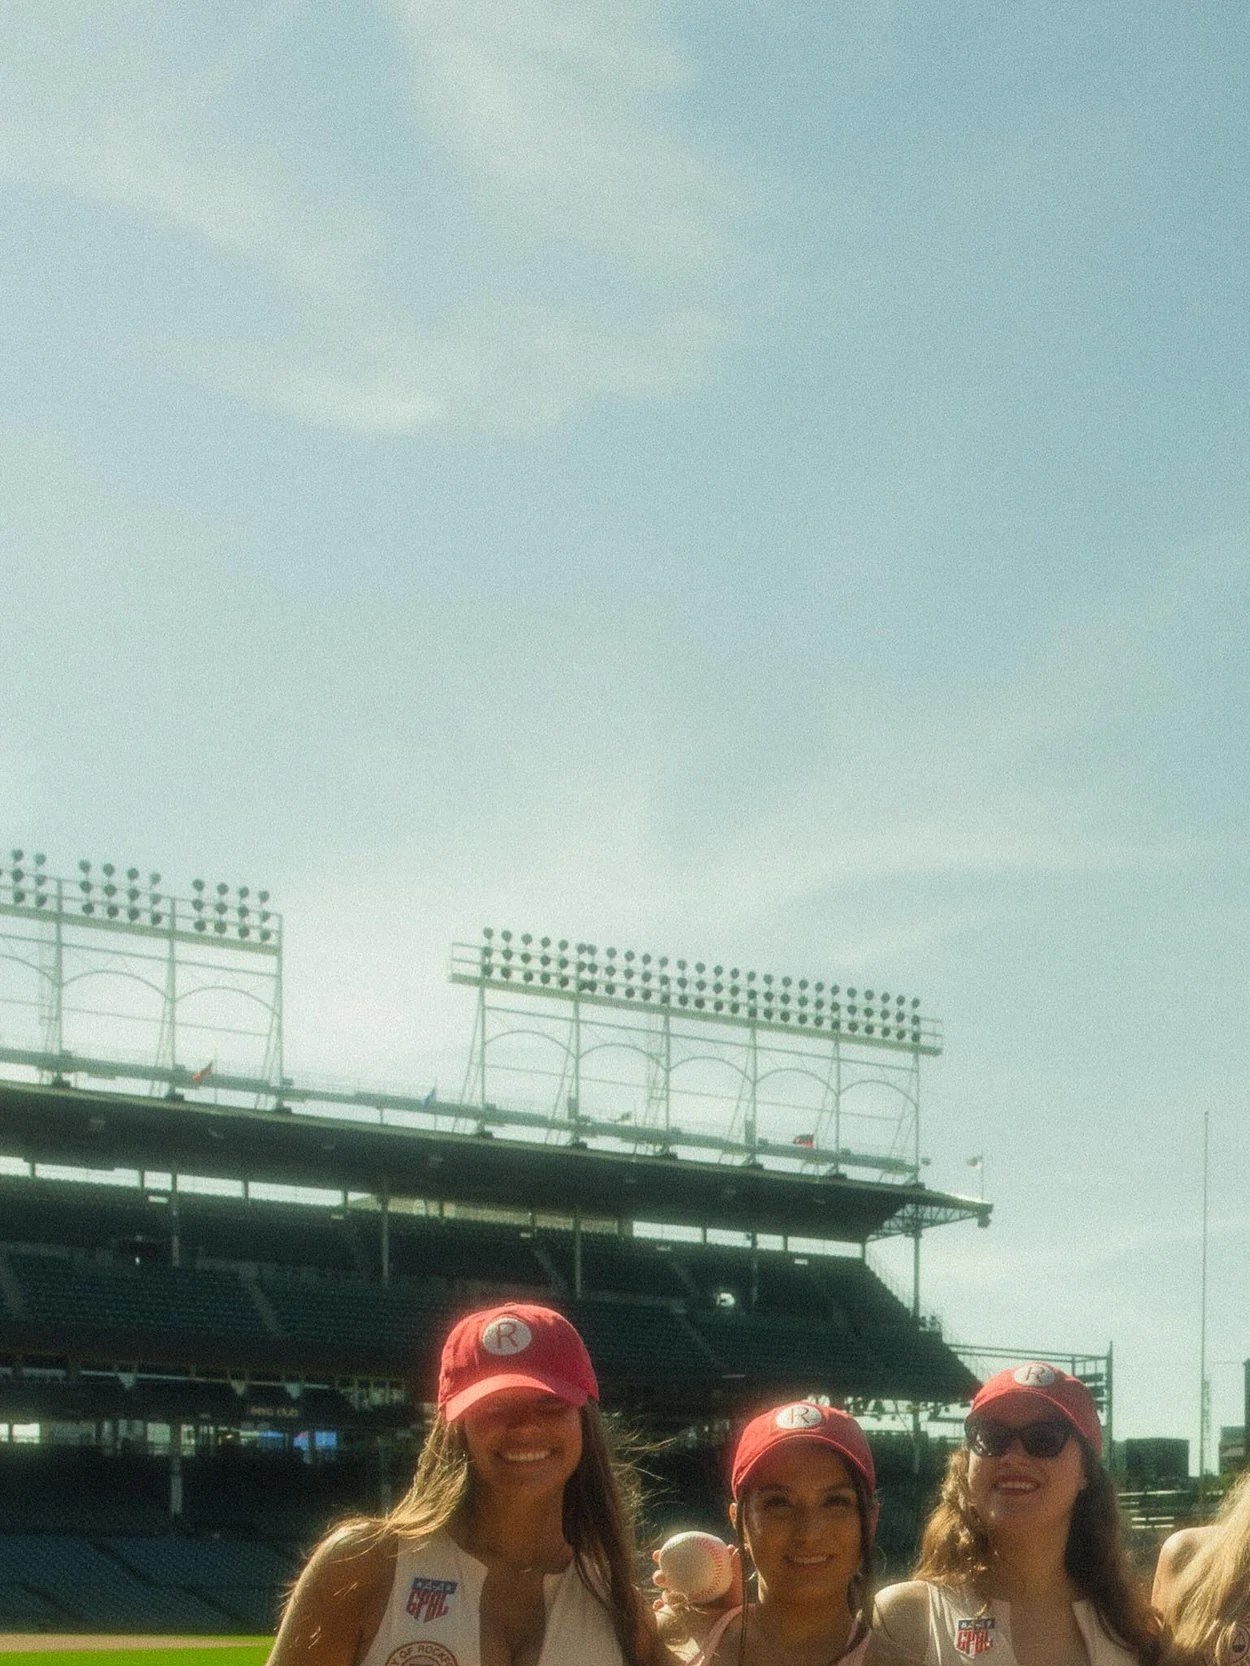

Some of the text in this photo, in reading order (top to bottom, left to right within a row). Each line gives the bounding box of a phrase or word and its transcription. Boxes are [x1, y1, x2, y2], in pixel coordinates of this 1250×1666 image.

[496, 1322, 518, 1349] R
[1026, 1366, 1046, 1384] R
[791, 1406, 809, 1425] R
[400, 1645, 412, 1658] OF
